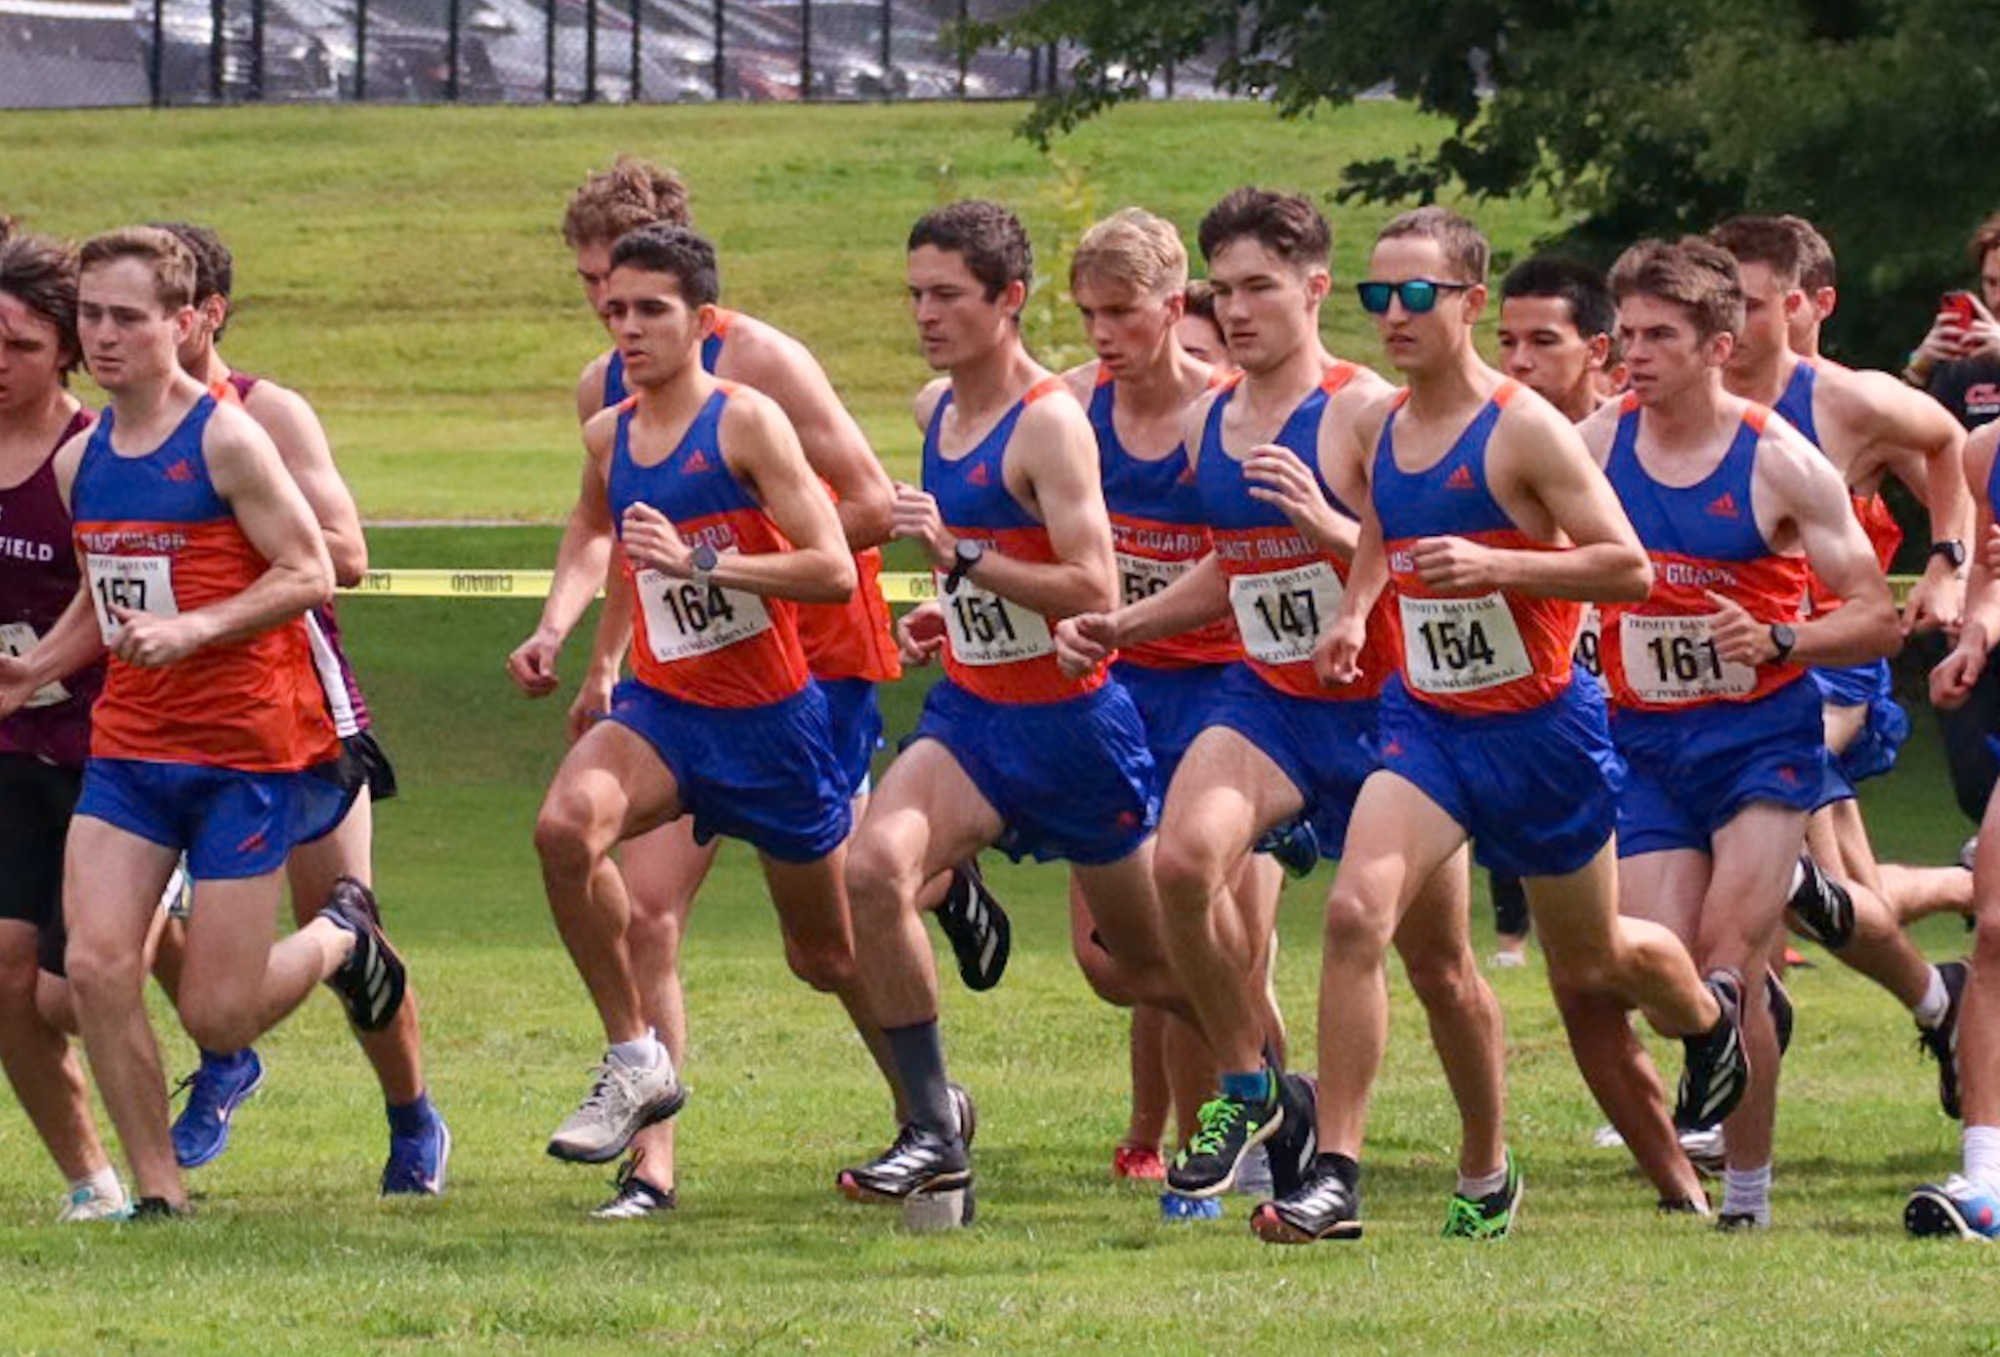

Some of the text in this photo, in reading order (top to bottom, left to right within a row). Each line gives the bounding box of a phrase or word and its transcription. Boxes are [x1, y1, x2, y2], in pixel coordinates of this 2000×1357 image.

[663, 584, 733, 635] 164
[953, 596, 1016, 643] 151
[1254, 587, 1319, 642] 147
[1418, 620, 1494, 670] 154
[1648, 637, 1722, 682] 161
